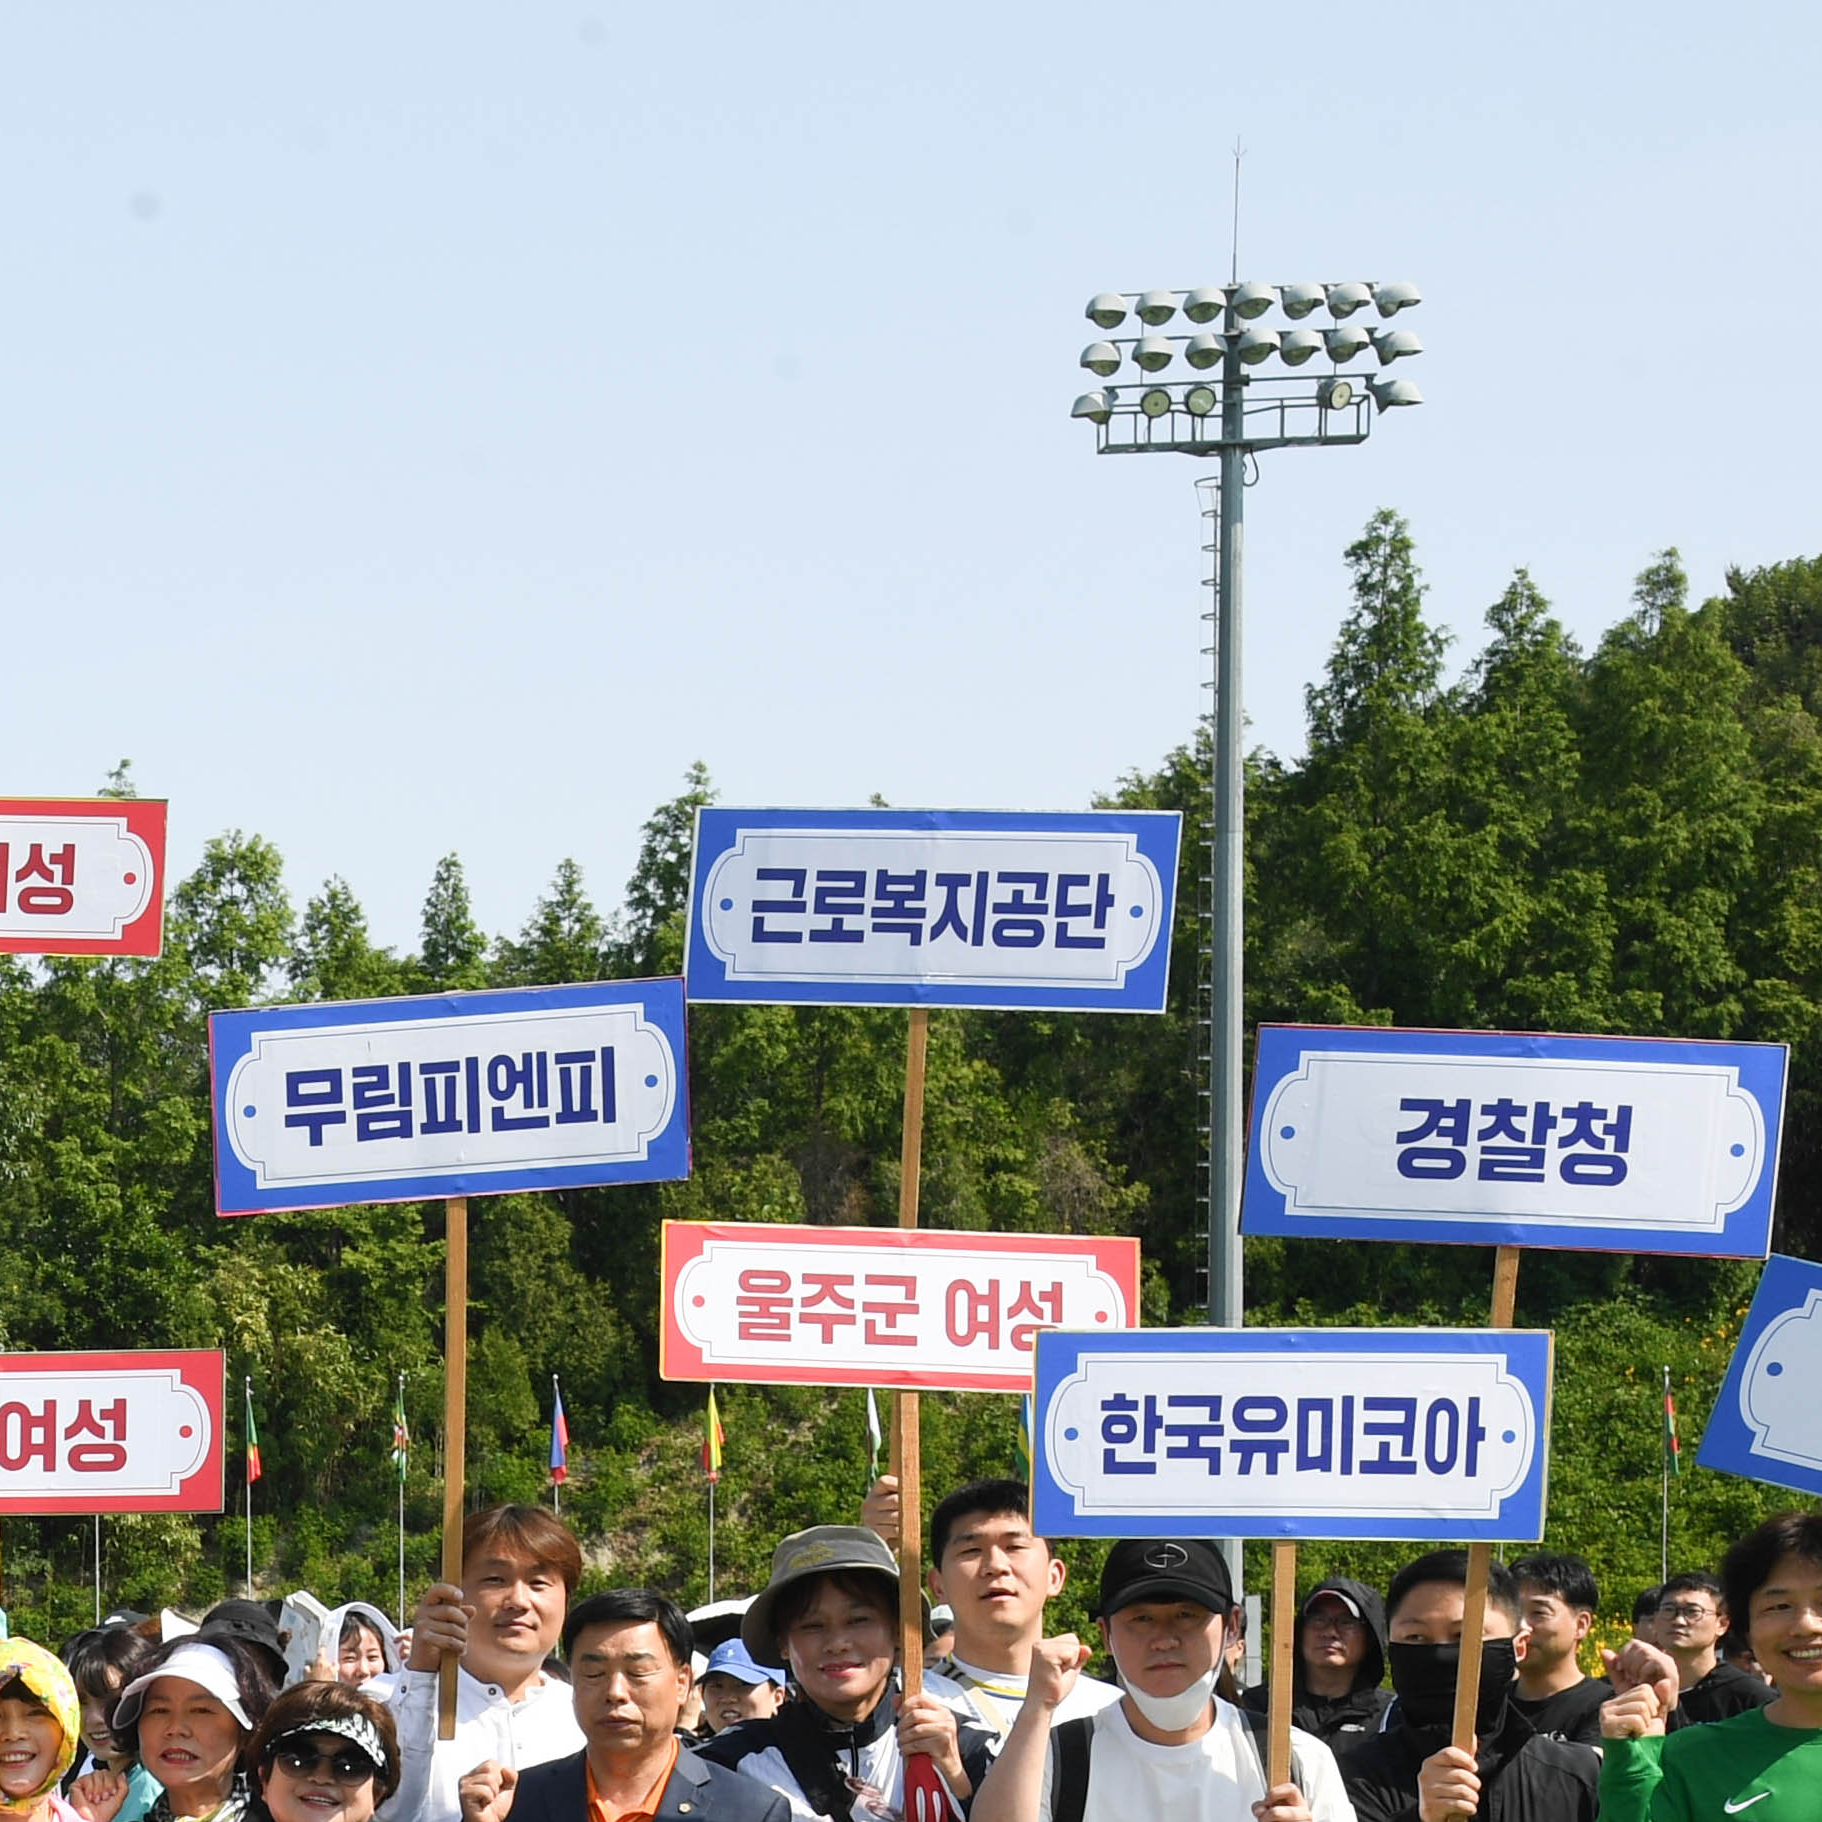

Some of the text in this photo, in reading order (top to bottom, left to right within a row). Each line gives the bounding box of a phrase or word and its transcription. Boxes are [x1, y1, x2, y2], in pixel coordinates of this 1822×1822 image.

[752, 868, 1113, 950] 근로복지공단
[284, 1047, 617, 1147] 무림피엔피
[1395, 1097, 1632, 1186] 경찰청
[741, 1272, 1064, 1352] 울주군 여성
[1107, 1398, 1483, 1473] 한국유미코아
